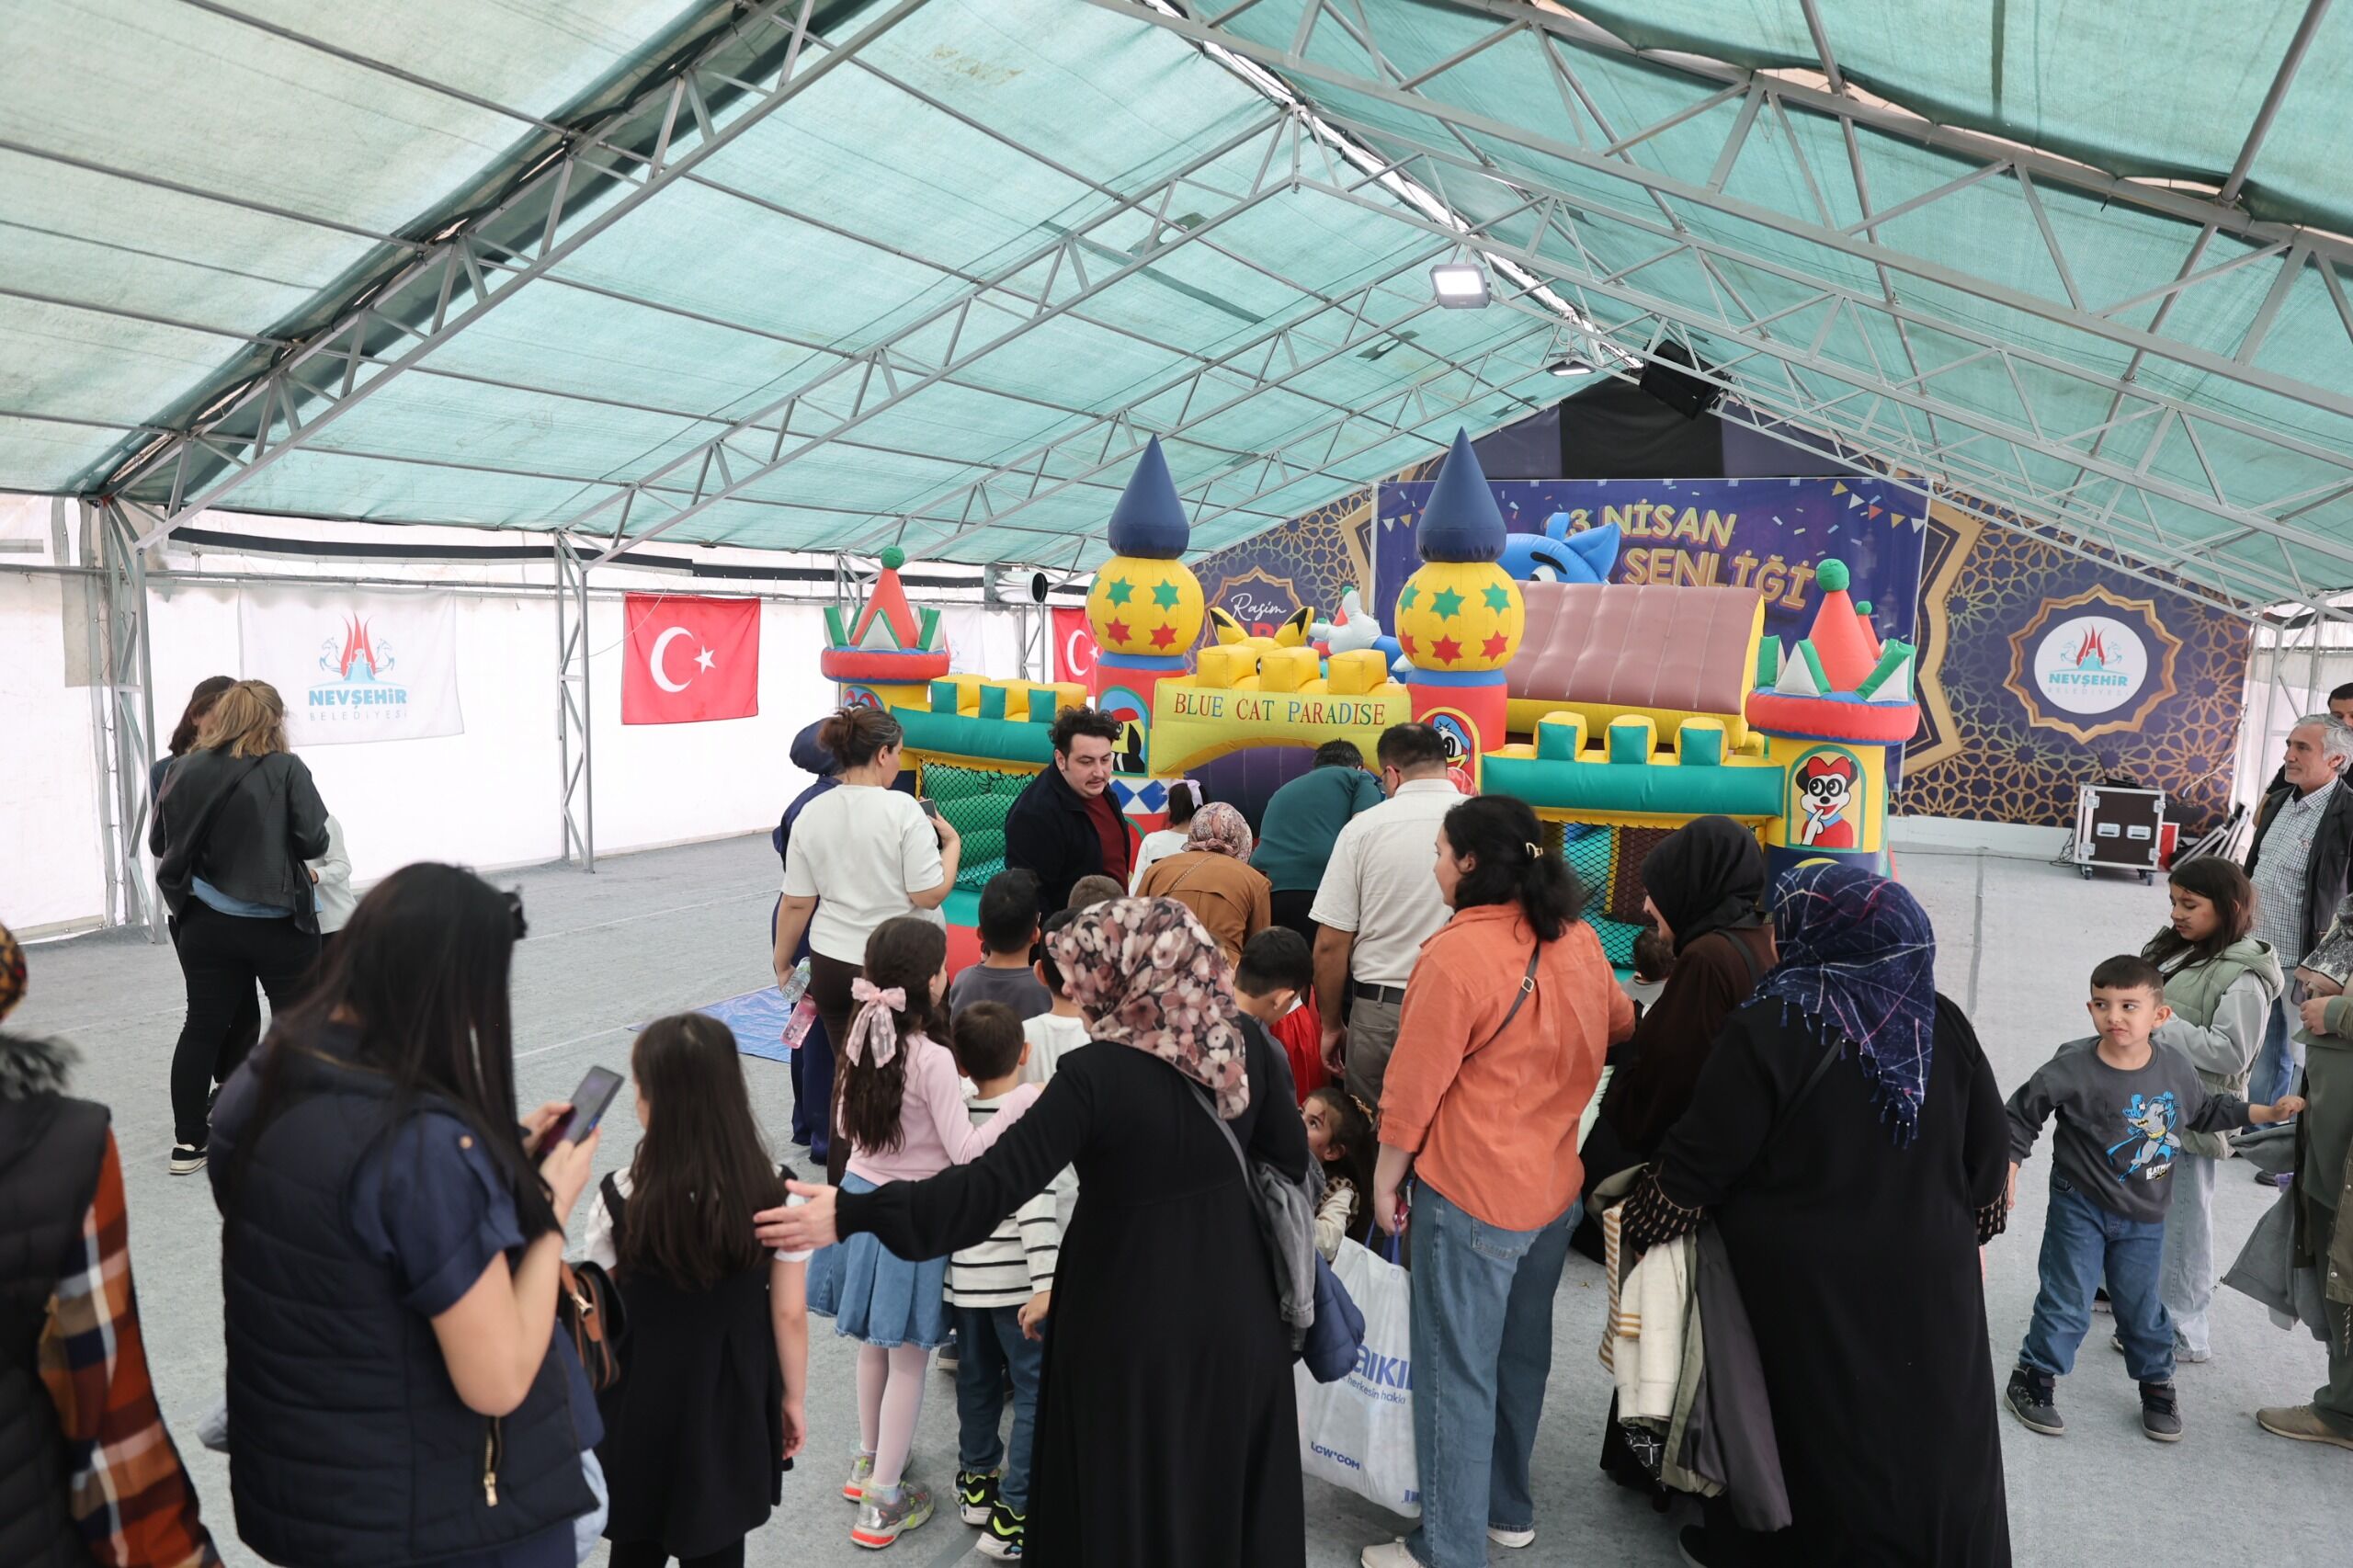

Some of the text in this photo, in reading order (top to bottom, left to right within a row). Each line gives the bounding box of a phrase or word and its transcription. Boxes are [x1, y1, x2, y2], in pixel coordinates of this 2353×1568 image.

[308, 687, 407, 710] NEVŞEHİR
[1175, 693, 1385, 726] BLUE CAT PARADISE
[1347, 1374, 1380, 1400] herkesin
